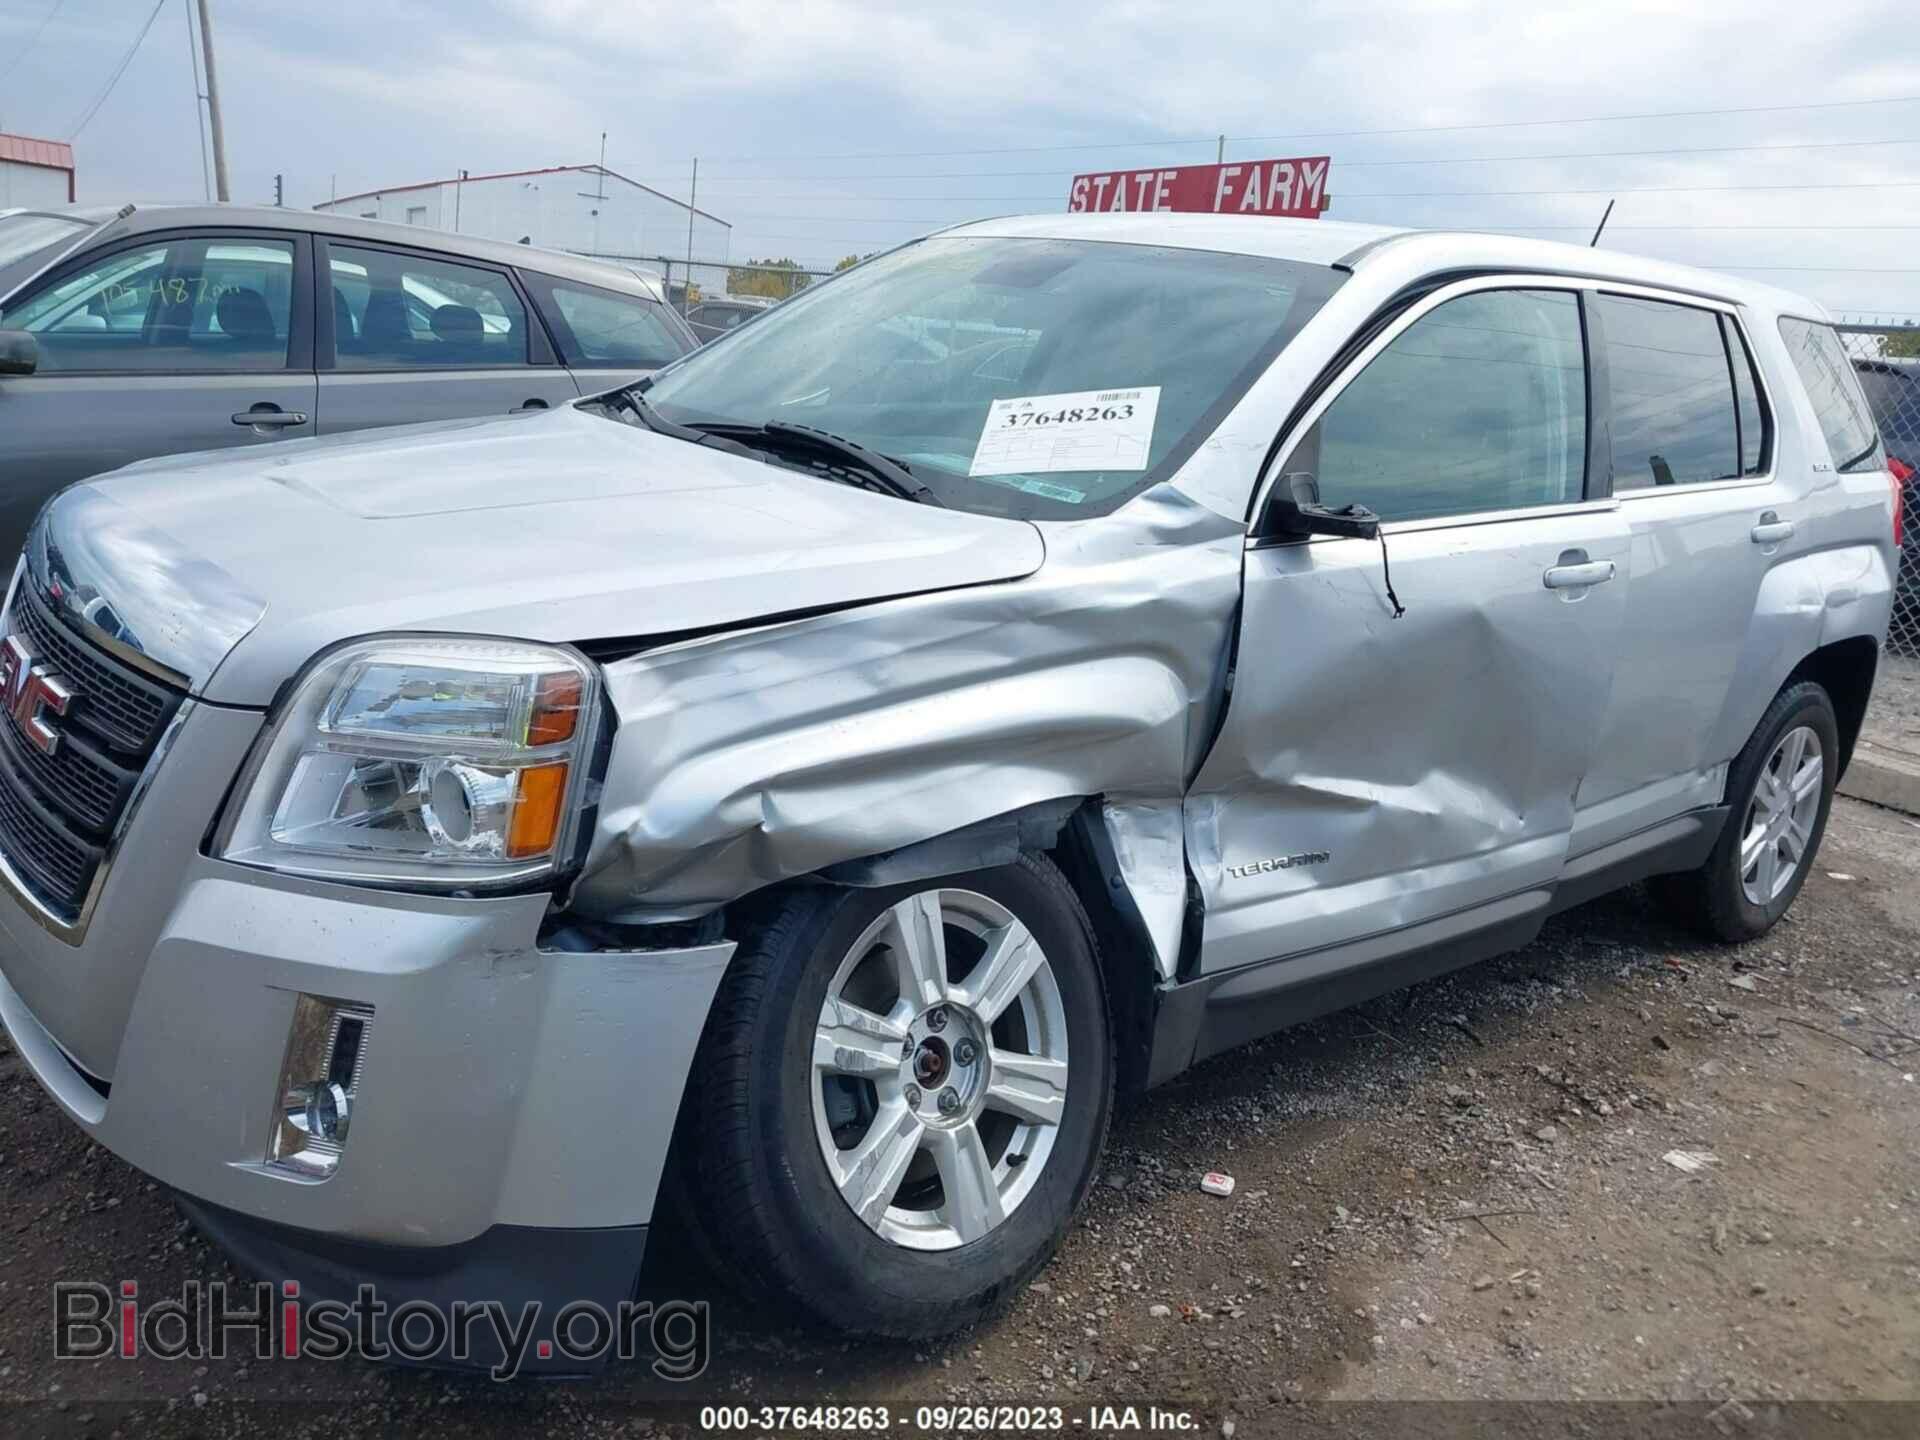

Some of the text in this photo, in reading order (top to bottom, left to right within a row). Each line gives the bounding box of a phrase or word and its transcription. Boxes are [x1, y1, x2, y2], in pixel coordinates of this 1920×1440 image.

[1070, 161, 1326, 213] STATE FARM
[1001, 404, 1134, 428] 37648263
[1227, 851, 1331, 879] TERRAIN
